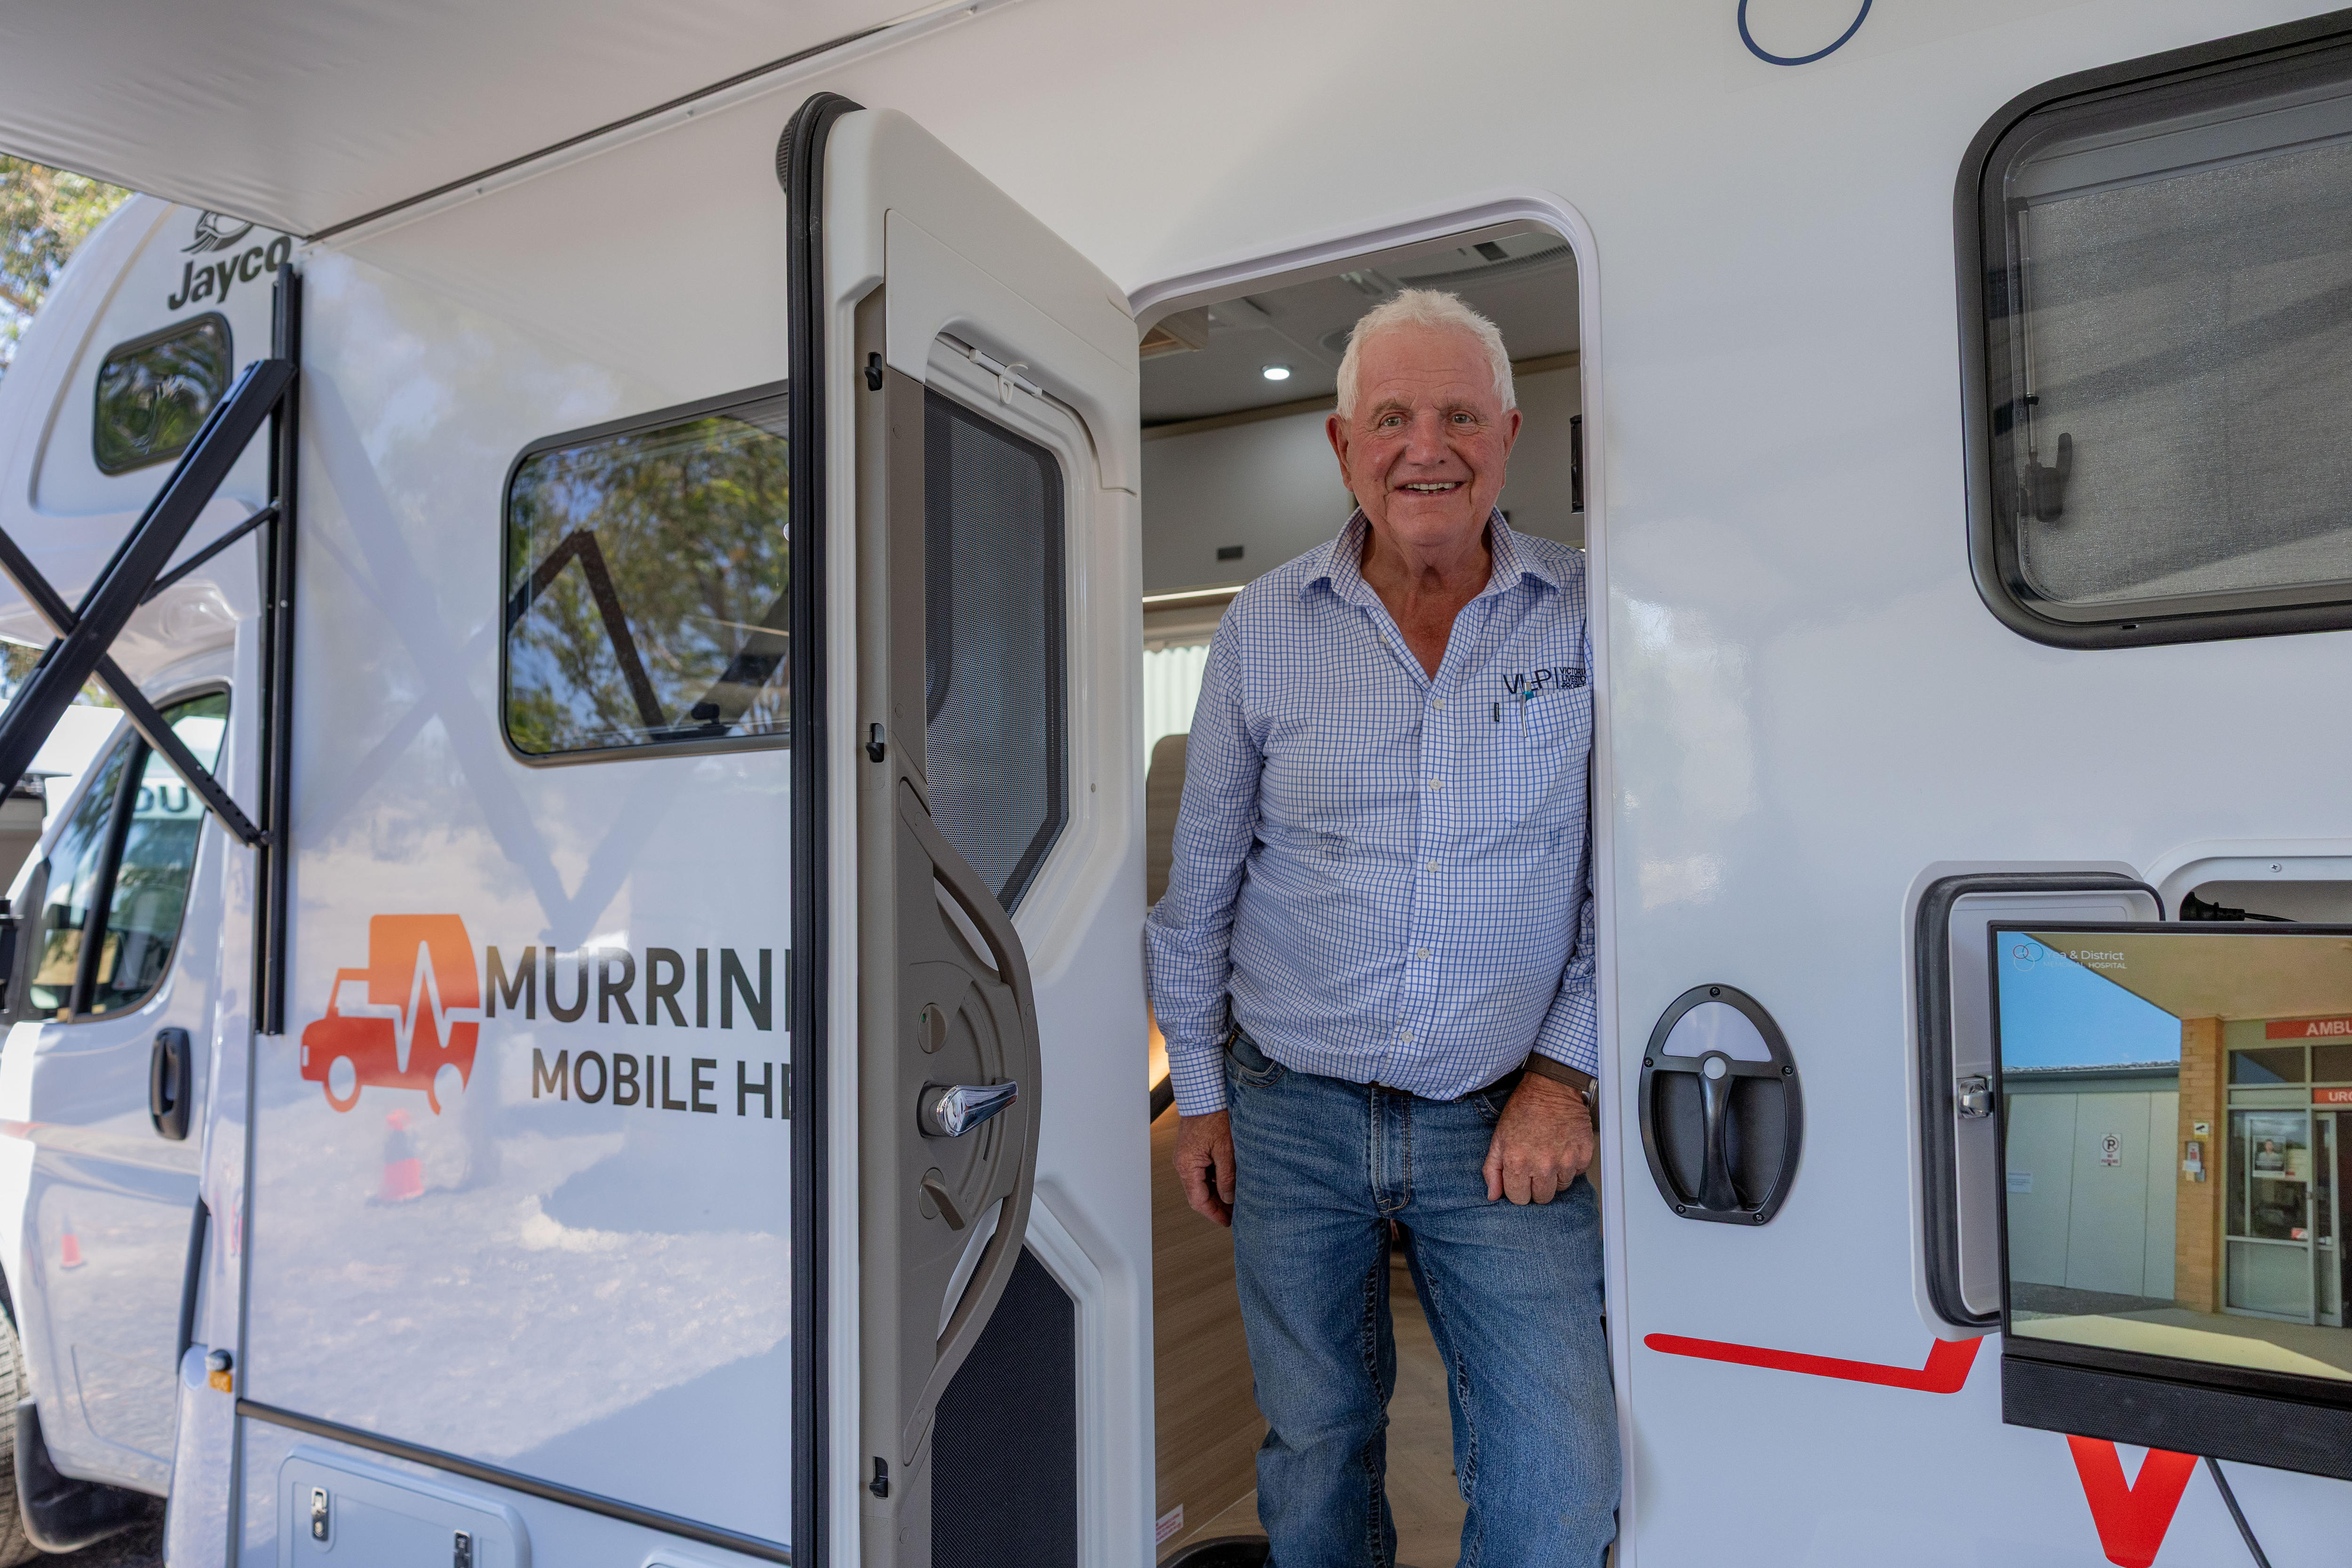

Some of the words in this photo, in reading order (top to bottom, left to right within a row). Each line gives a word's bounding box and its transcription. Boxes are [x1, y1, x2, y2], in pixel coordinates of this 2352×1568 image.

[168, 236, 291, 310] Jayco
[486, 946, 791, 1032] MURRIN
[2070, 950, 2078, 959] &
[2081, 950, 2124, 960] District
[532, 1048, 717, 1114] MOBILE
